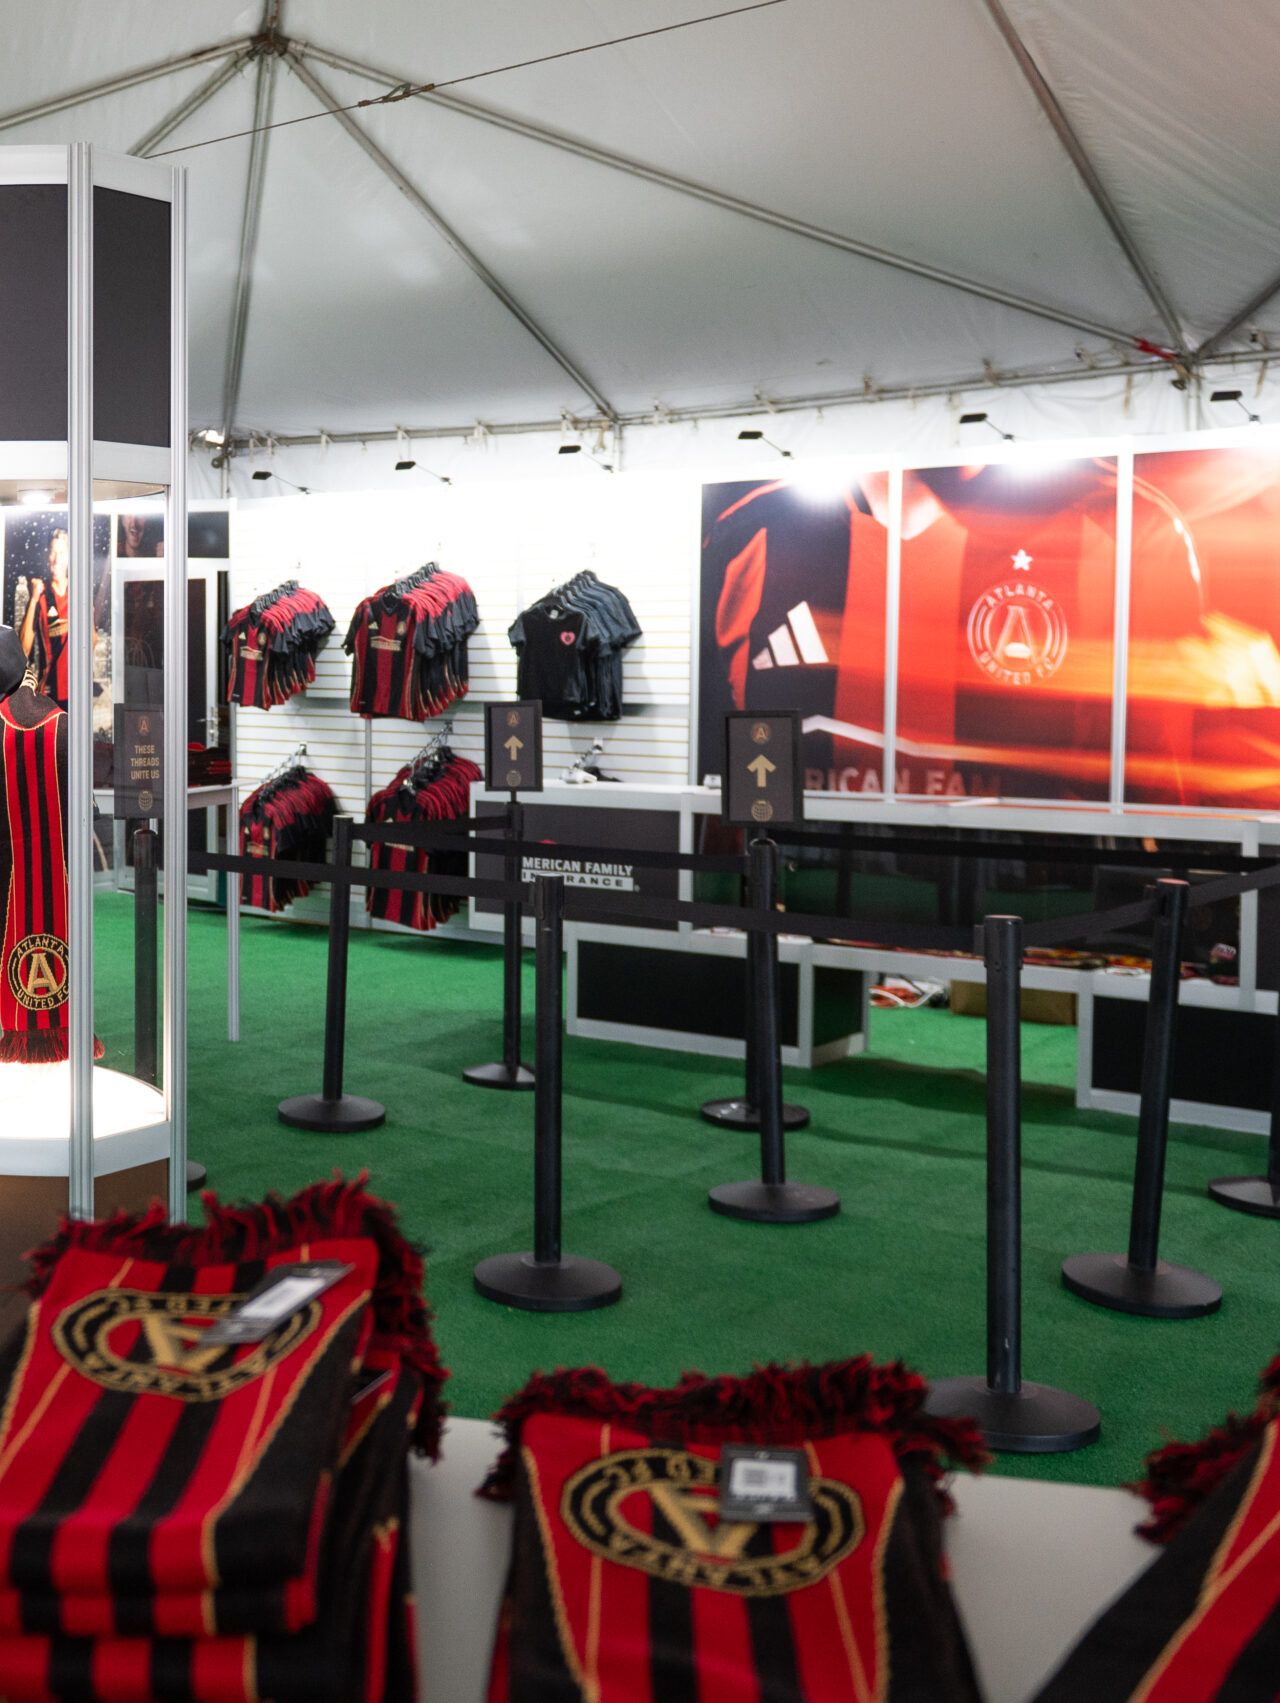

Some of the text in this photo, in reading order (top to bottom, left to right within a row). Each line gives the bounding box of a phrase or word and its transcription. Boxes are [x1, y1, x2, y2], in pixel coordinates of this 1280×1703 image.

[985, 583, 1054, 611] ATLANTA
[134, 745, 155, 754] THESE
[130, 758, 160, 767] THREADS
[131, 770, 160, 780] UNITE US
[804, 767, 910, 794] RICAN
[522, 856, 633, 876] MERICAN FAMILY
[523, 872, 624, 887] INRANCE
[17, 936, 64, 957] ATLANTA
[17, 988, 55, 1009] UNITED
